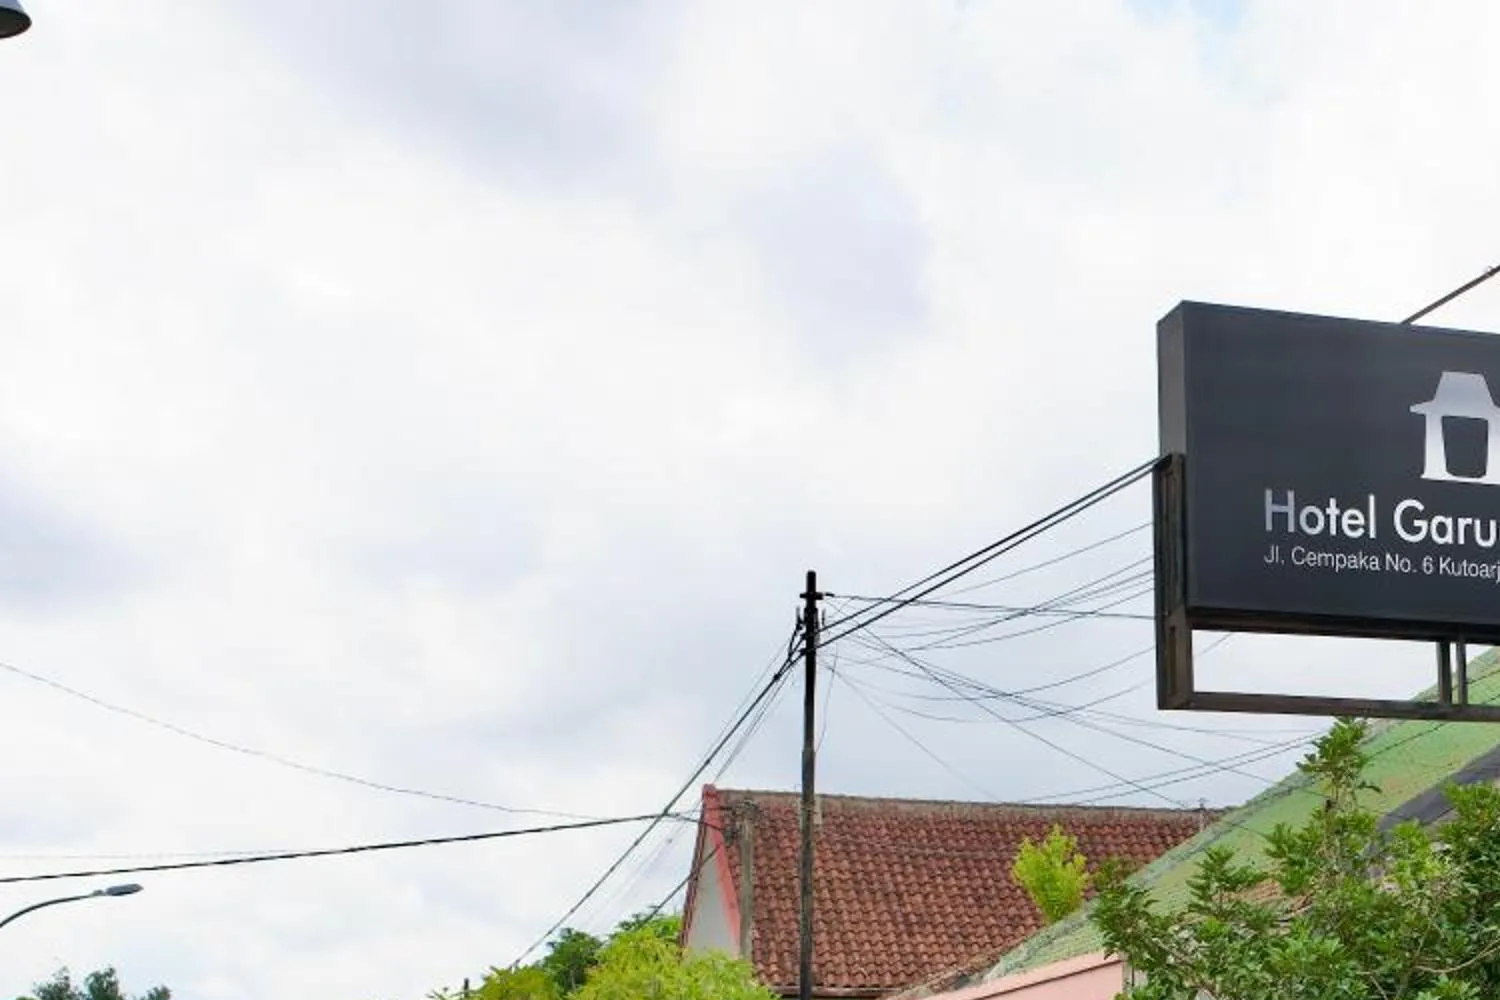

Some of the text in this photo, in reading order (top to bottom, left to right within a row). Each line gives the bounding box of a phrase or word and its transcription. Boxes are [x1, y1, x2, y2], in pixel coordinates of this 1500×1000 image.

[1264, 489, 1376, 538] Hotel
[1291, 546, 1380, 573] Cempaka
[1385, 553, 1417, 574] No.
[1422, 556, 1434, 575] 6
